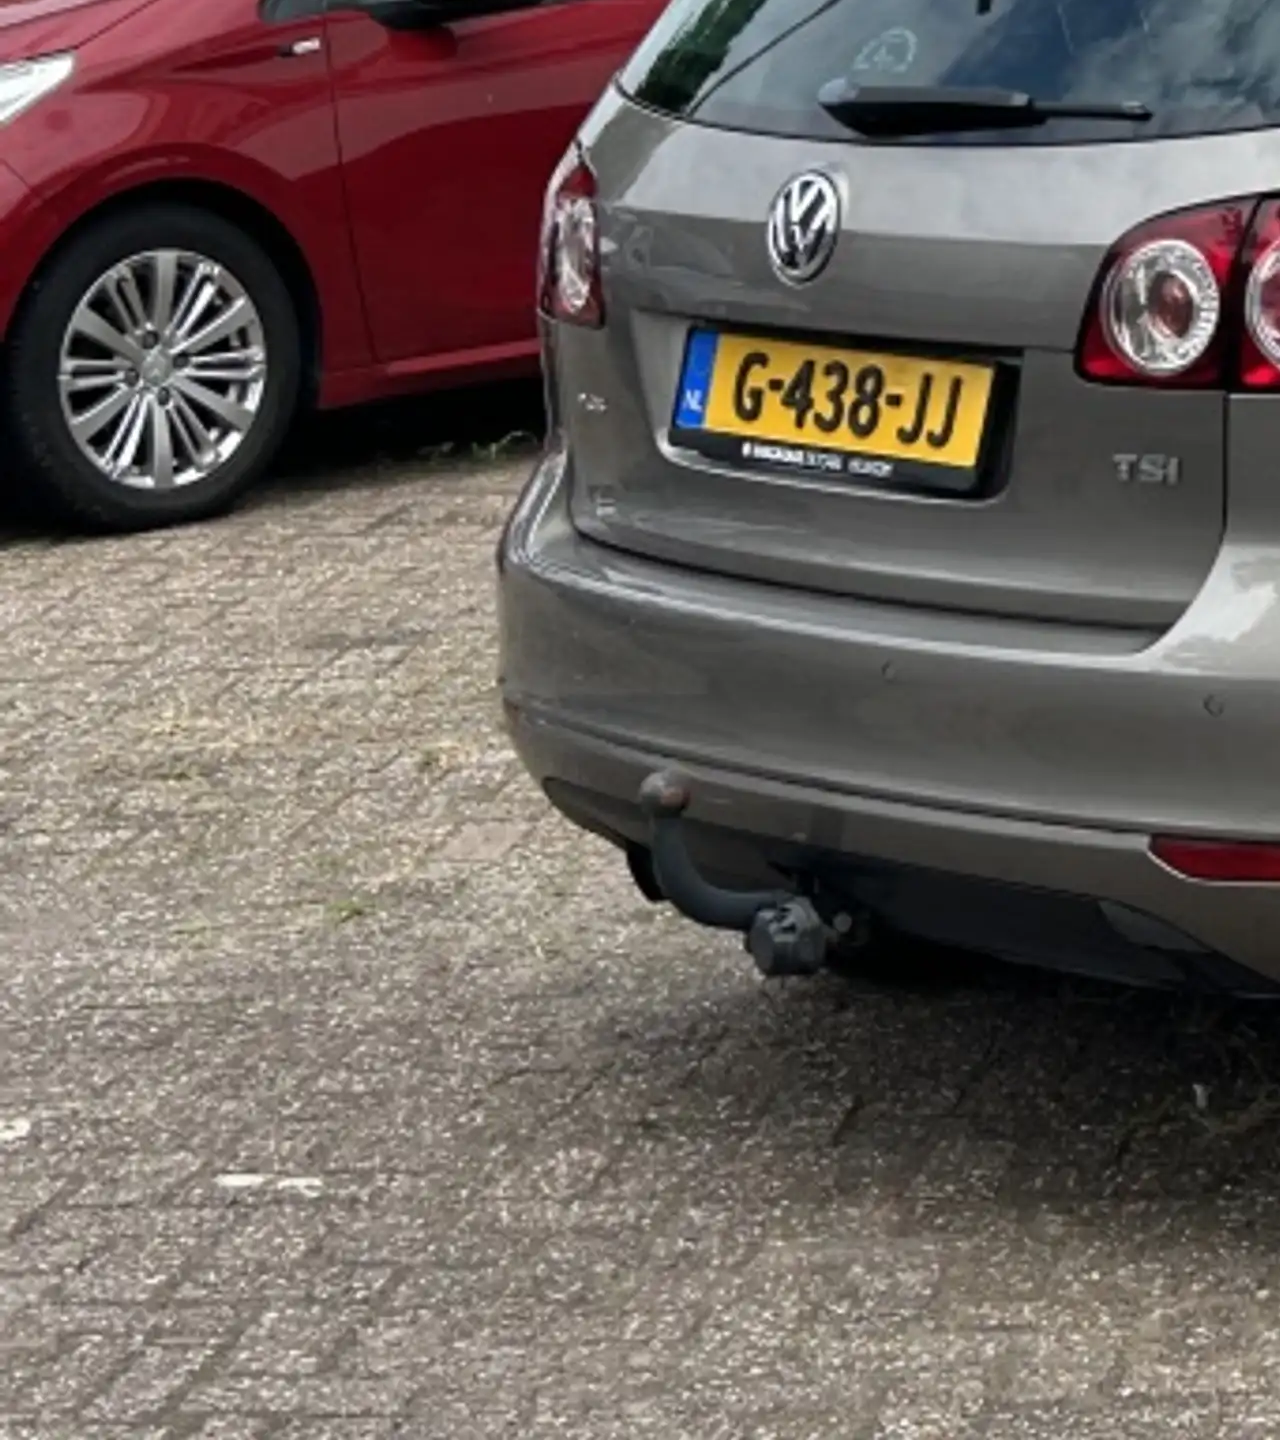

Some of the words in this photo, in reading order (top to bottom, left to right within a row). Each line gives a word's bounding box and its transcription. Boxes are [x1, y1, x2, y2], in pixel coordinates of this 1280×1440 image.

[683, 389, 703, 412] NL
[733, 352, 964, 449] G-438-JJ
[1112, 453, 1179, 486] TSI
